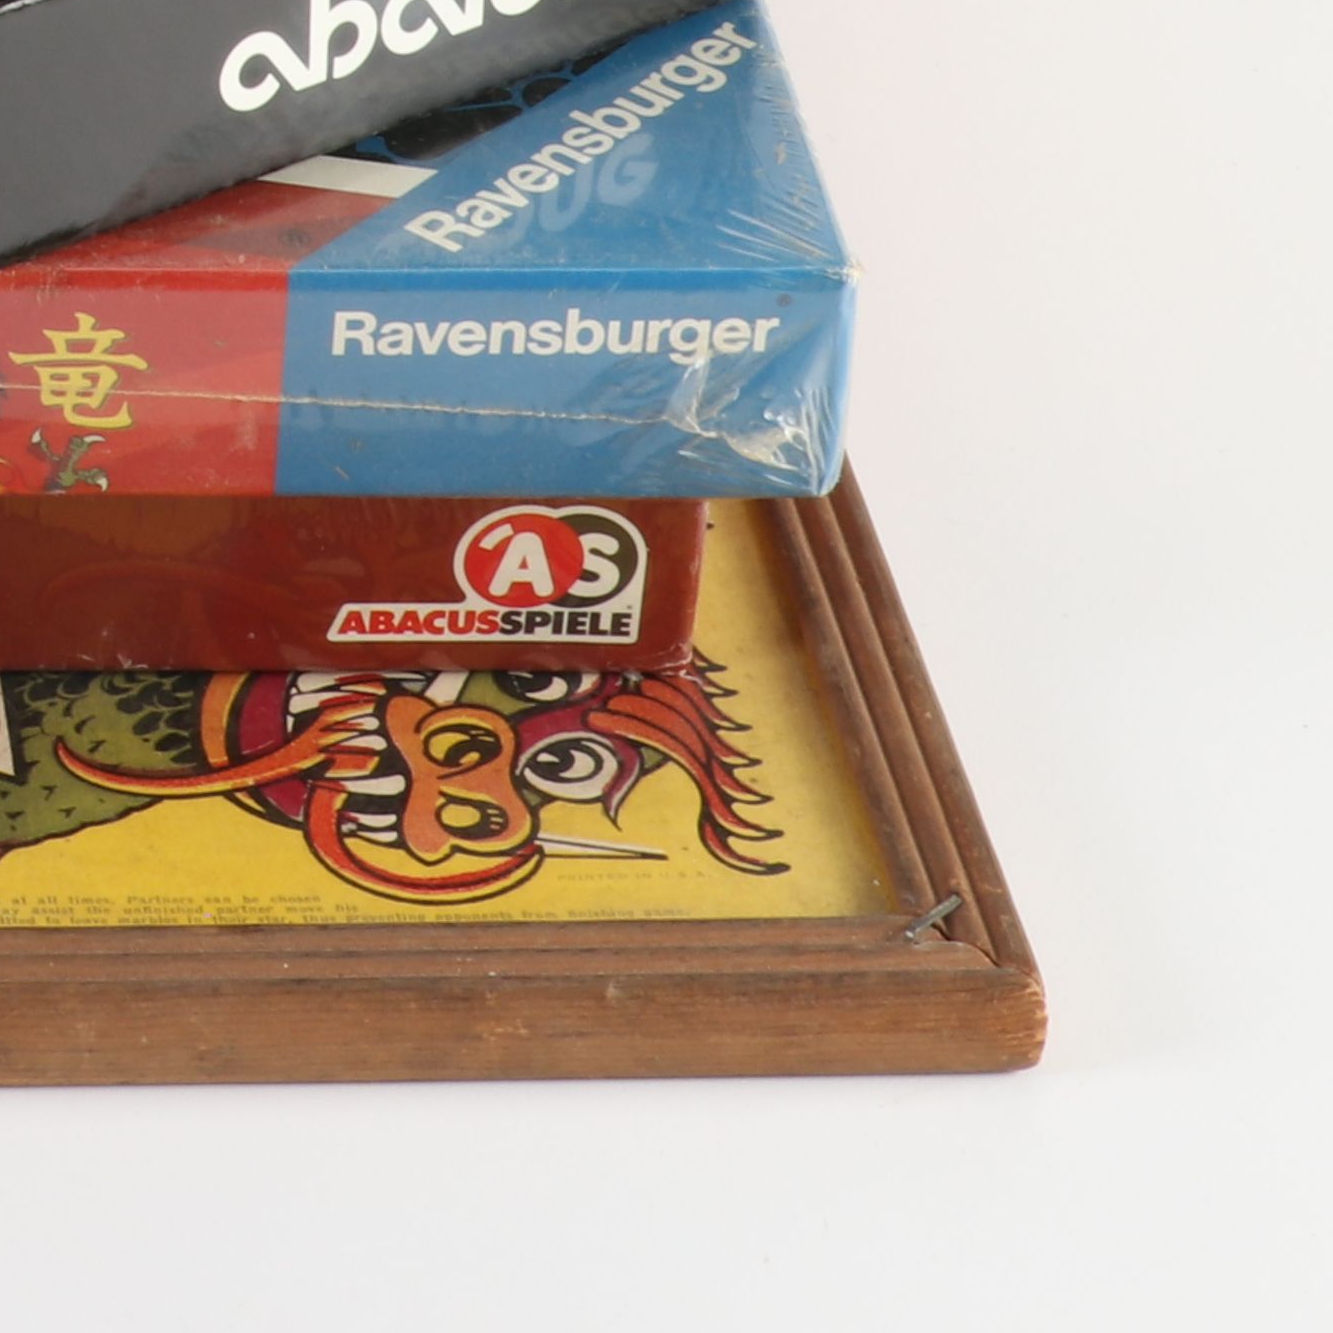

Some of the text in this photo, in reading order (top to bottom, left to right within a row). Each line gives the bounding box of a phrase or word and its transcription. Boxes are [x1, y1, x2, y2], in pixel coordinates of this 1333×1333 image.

[403, 21, 757, 253] Ravensburger
[8, 310, 149, 430] 竜
[331, 308, 780, 365] Ravensburger
[337, 609, 633, 637] ABACUSSPIELE
